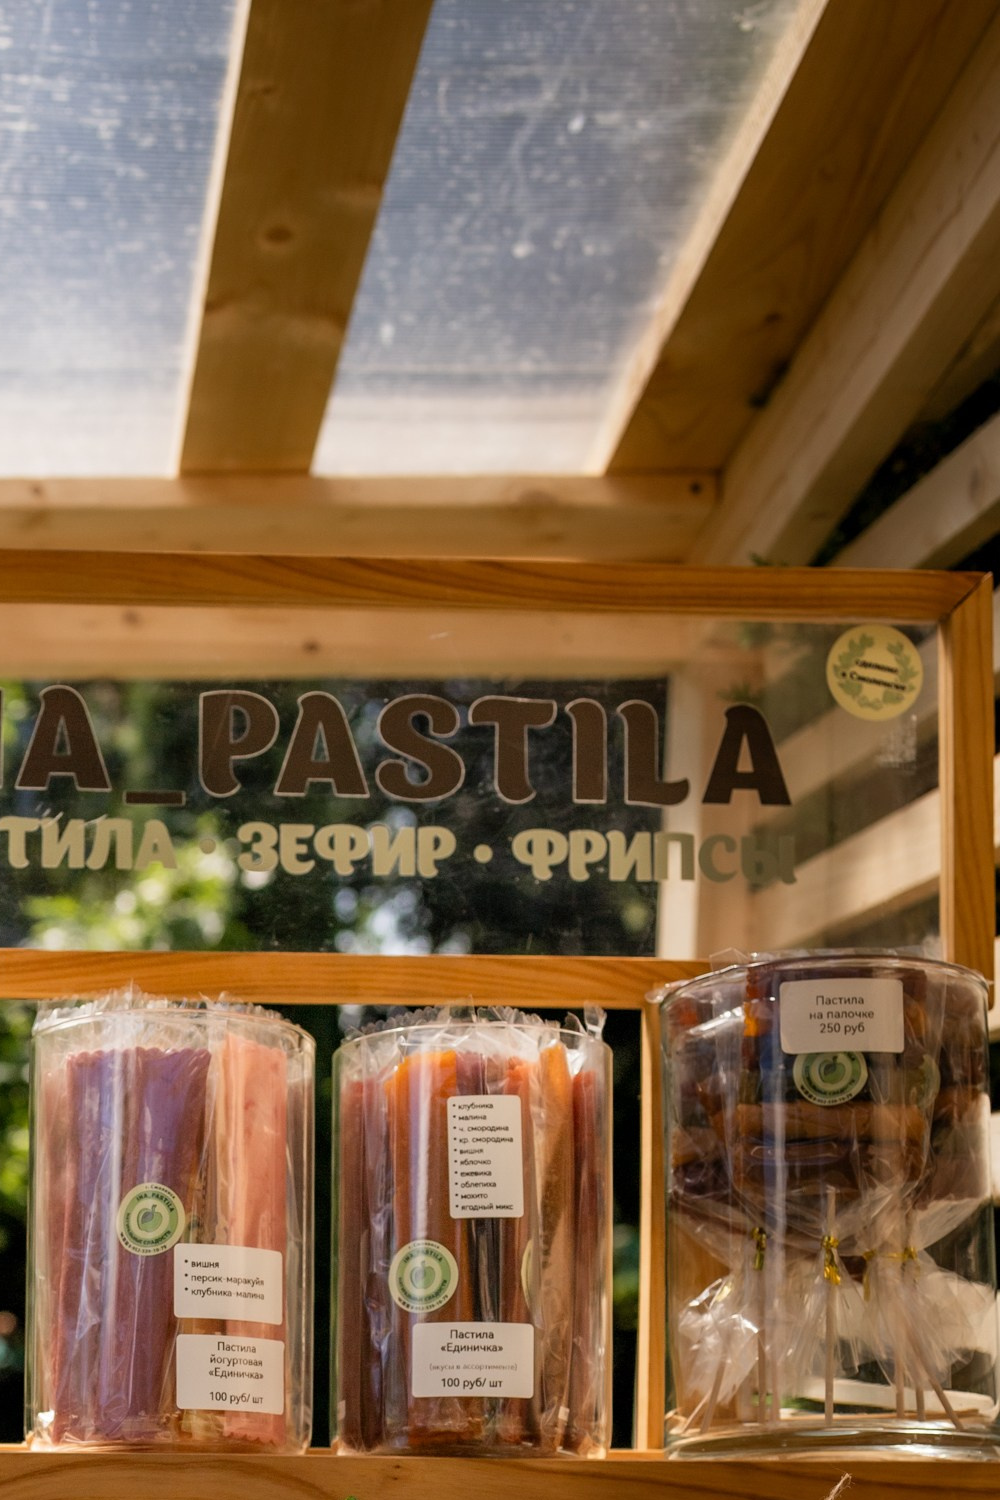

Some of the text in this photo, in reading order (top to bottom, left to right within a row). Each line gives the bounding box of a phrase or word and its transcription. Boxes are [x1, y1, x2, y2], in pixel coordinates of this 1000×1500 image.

[237, 821, 457, 879] ЗЕФИР
[512, 828, 797, 885] ФРИПСЫ
[815, 995, 865, 1006] Пастила
[809, 1010, 875, 1020] на палочке
[820, 1022, 865, 1035] 250 руб
[458, 1102, 494, 1111] клубника
[467, 1125, 509, 1133] смородина
[471, 1136, 514, 1144] смородина
[460, 1181, 497, 1189] облепиха
[461, 1203, 494, 1211] ягодный
[191, 1260, 220, 1268] вишня
[450, 1329, 494, 1340] Пастила
[217, 1341, 256, 1353] Пастила
[440, 1343, 504, 1353] «Единичка»
[210, 1354, 263, 1367] йогуртовая
[208, 1367, 264, 1380] «Единичка»
[441, 1378, 503, 1390] 100 руб/ шт
[209, 1391, 263, 1405] 100 руб/ шт
